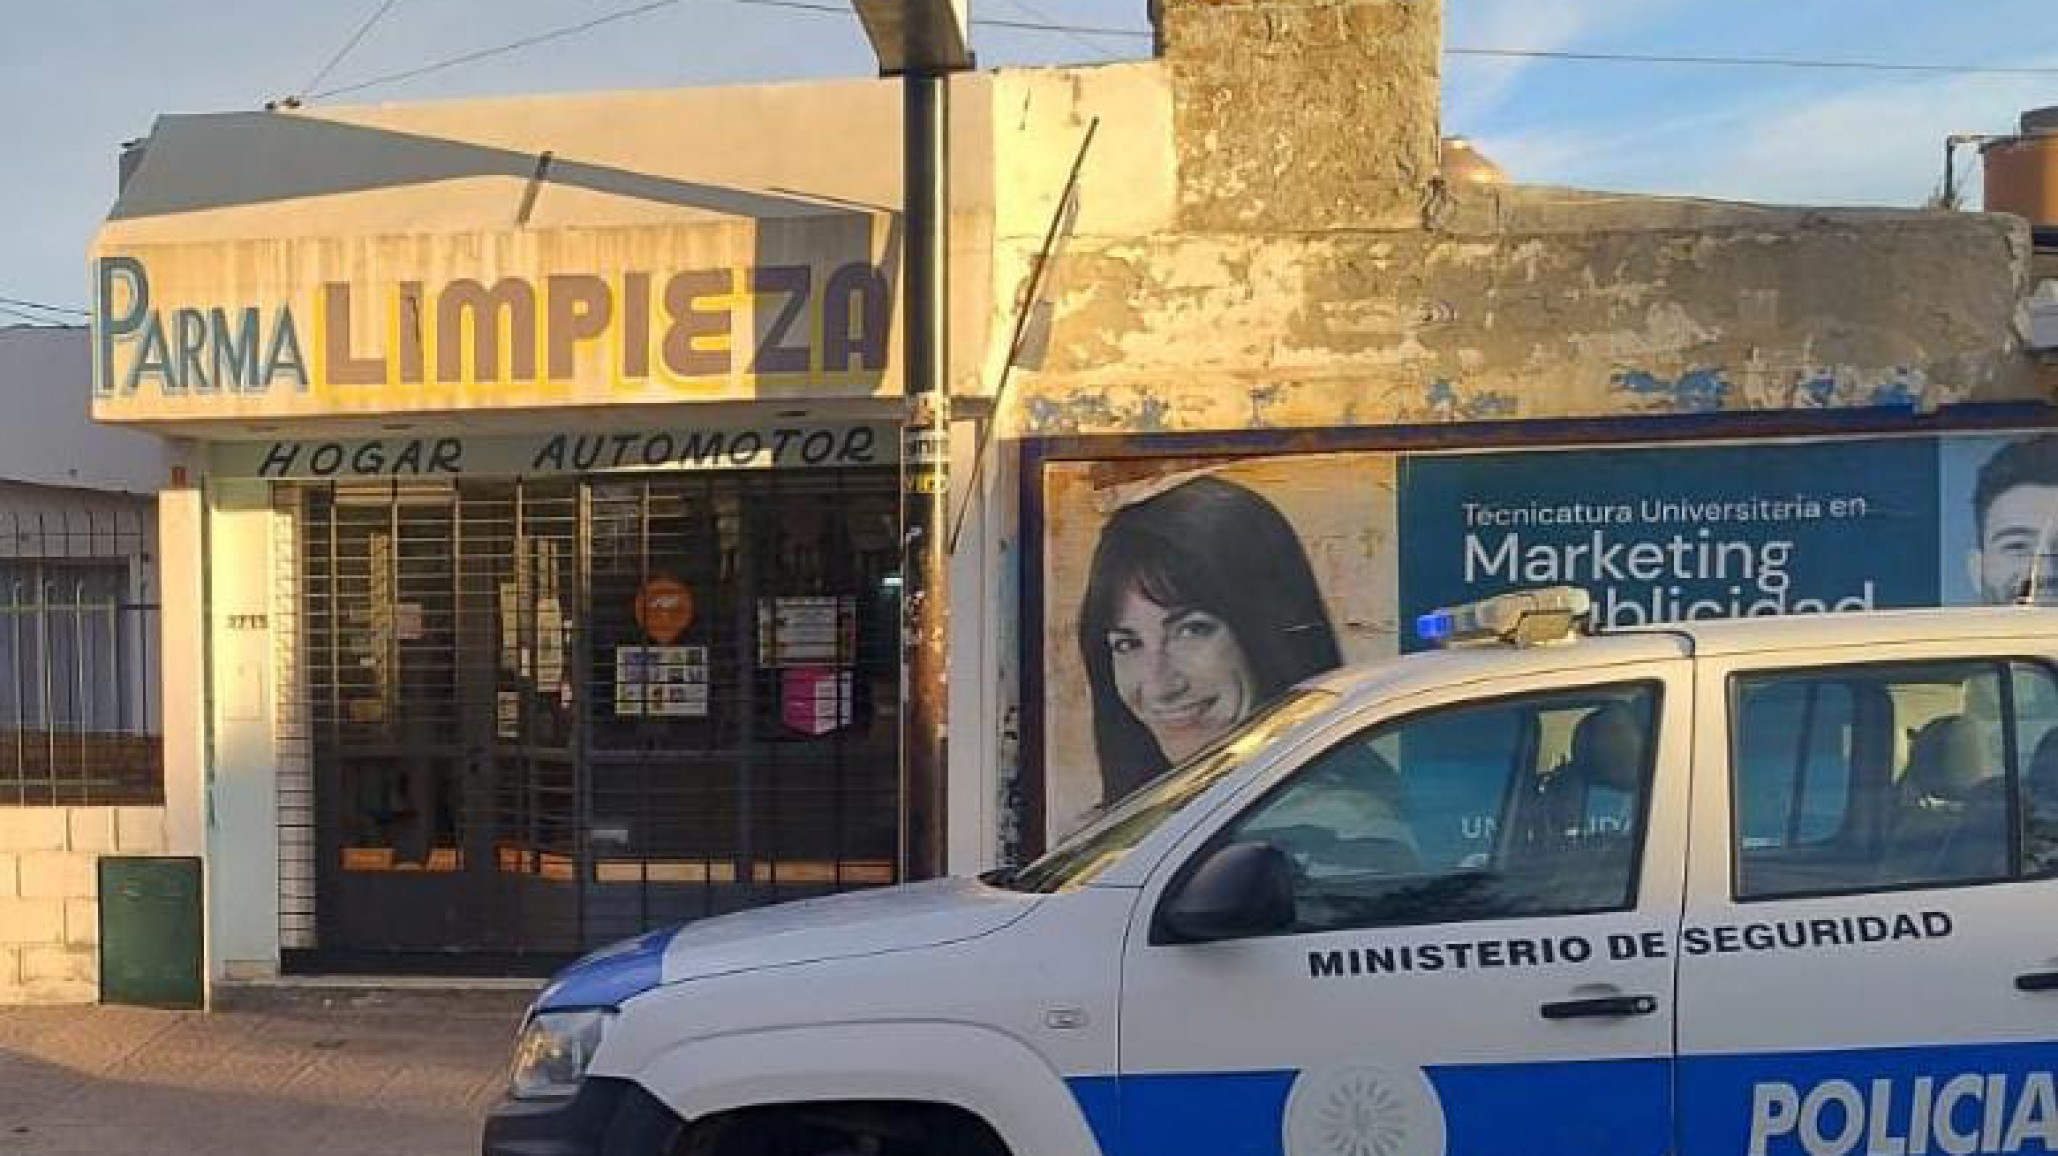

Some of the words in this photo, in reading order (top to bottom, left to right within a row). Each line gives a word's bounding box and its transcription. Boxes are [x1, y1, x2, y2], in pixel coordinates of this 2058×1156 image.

[96, 256, 309, 398] PARMA
[324, 261, 889, 386] LIMPIEZA
[257, 437, 464, 477] HOGAR
[533, 426, 876, 470] AUTOMOTOR
[1461, 501, 1632, 527] Tecnicatura
[1641, 496, 1820, 522] Universitaria
[1830, 496, 1867, 518] en
[1463, 528, 1794, 593] Marketing
[1308, 935, 1593, 979] MINISTERIO
[1607, 931, 1667, 961] DE
[1683, 911, 1953, 956] SEGURIDAD
[1749, 1071, 2058, 1156] POLICIA
